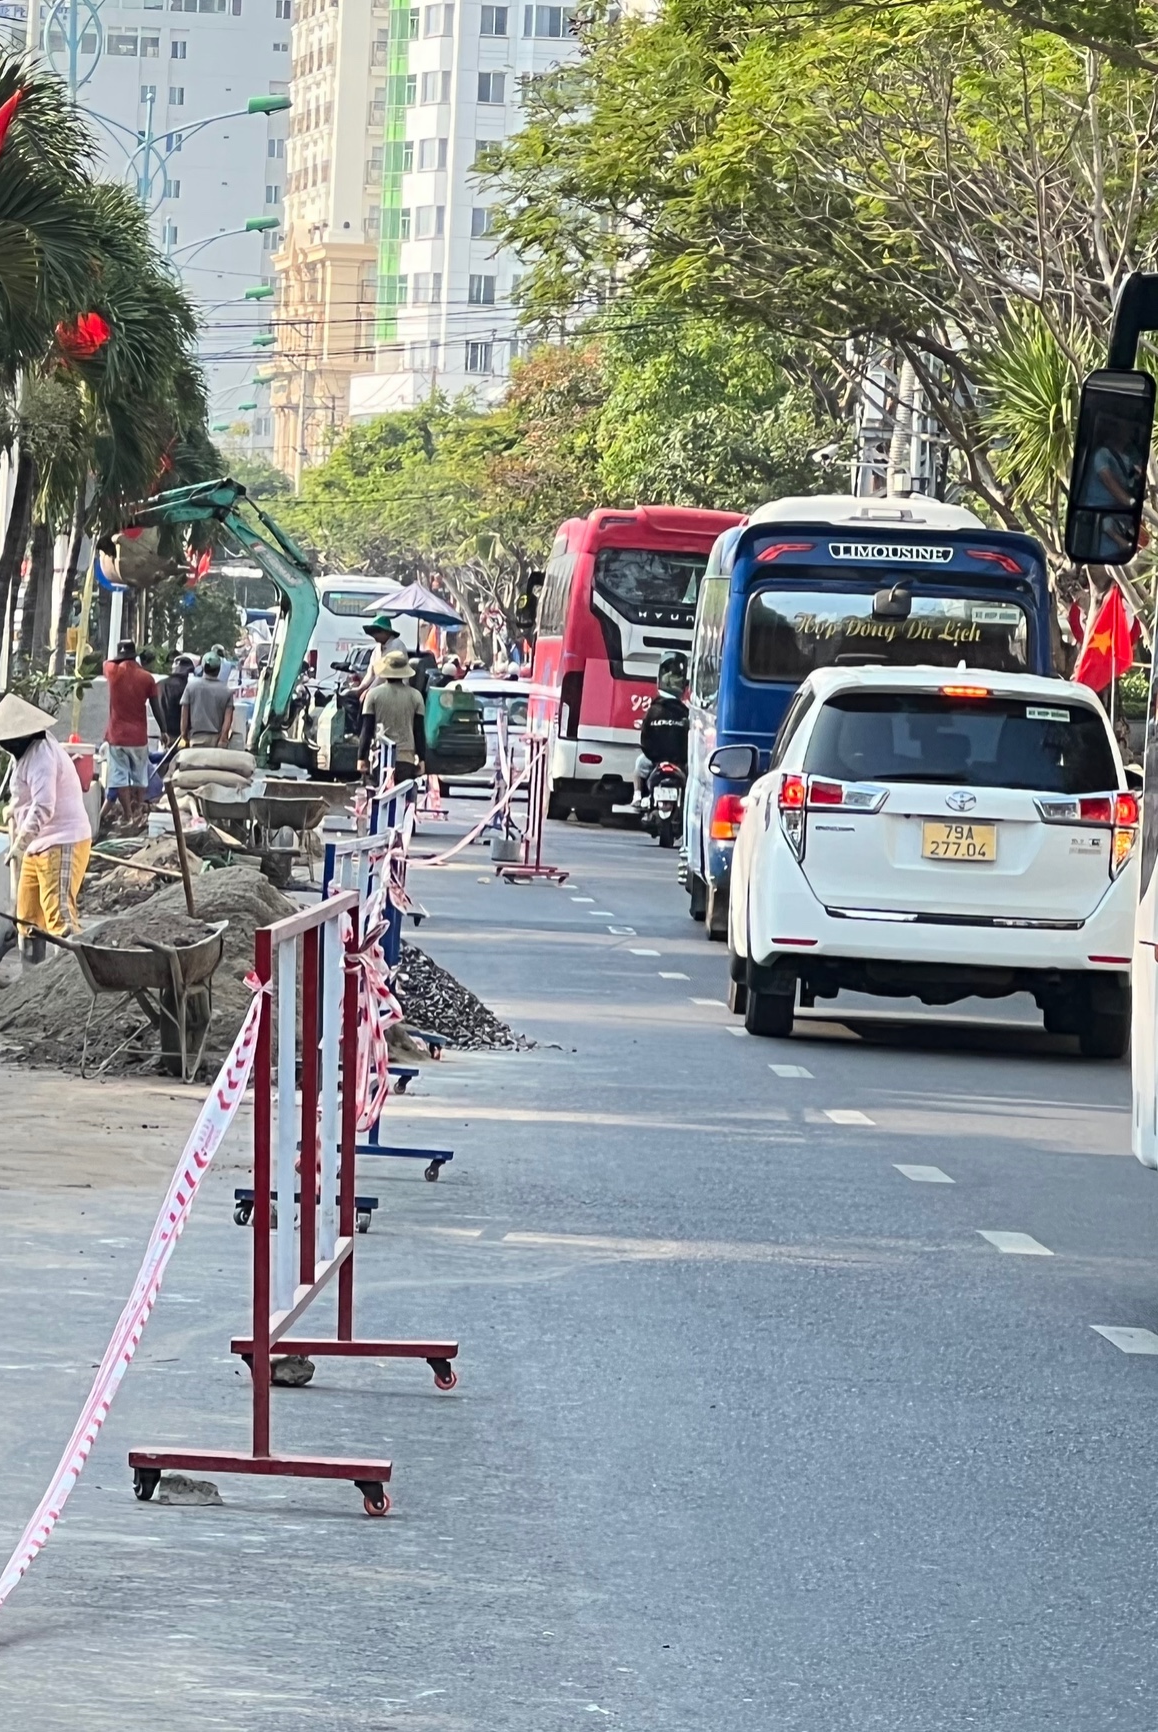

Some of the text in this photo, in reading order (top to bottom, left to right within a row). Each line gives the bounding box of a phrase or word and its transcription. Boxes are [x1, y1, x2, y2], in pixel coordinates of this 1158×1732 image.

[839, 545, 944, 561] LIMOUSINE
[906, 620, 934, 641] Du
[937, 620, 982, 647] Lịch
[944, 824, 974, 841] 79A
[930, 840, 987, 857] 277.04
